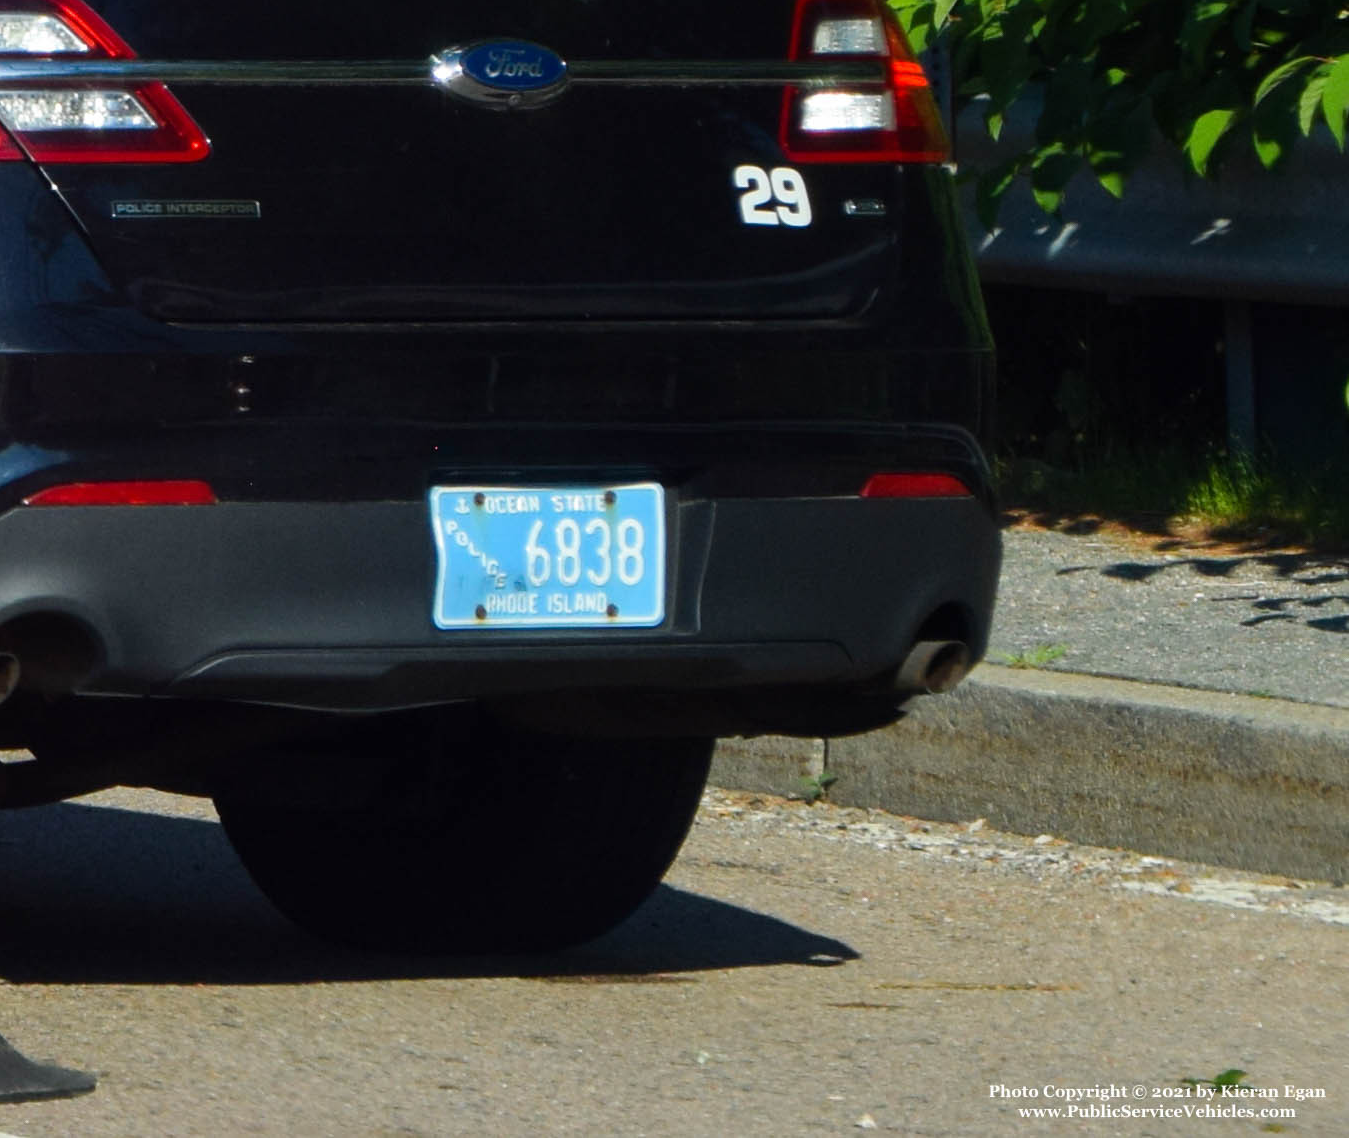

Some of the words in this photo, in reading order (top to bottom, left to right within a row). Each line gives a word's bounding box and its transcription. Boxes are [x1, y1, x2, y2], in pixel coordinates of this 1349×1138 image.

[485, 49, 543, 78] Ford
[115, 203, 163, 214] POLICE
[166, 203, 255, 214] INTERCEPTOR
[734, 165, 812, 228] 29
[485, 495, 540, 514] OCEAN
[551, 493, 606, 513] STATE
[445, 520, 507, 590] POLICE
[525, 518, 645, 587] 6838
[486, 593, 539, 614] RHODE
[547, 593, 607, 614] ISLAND
